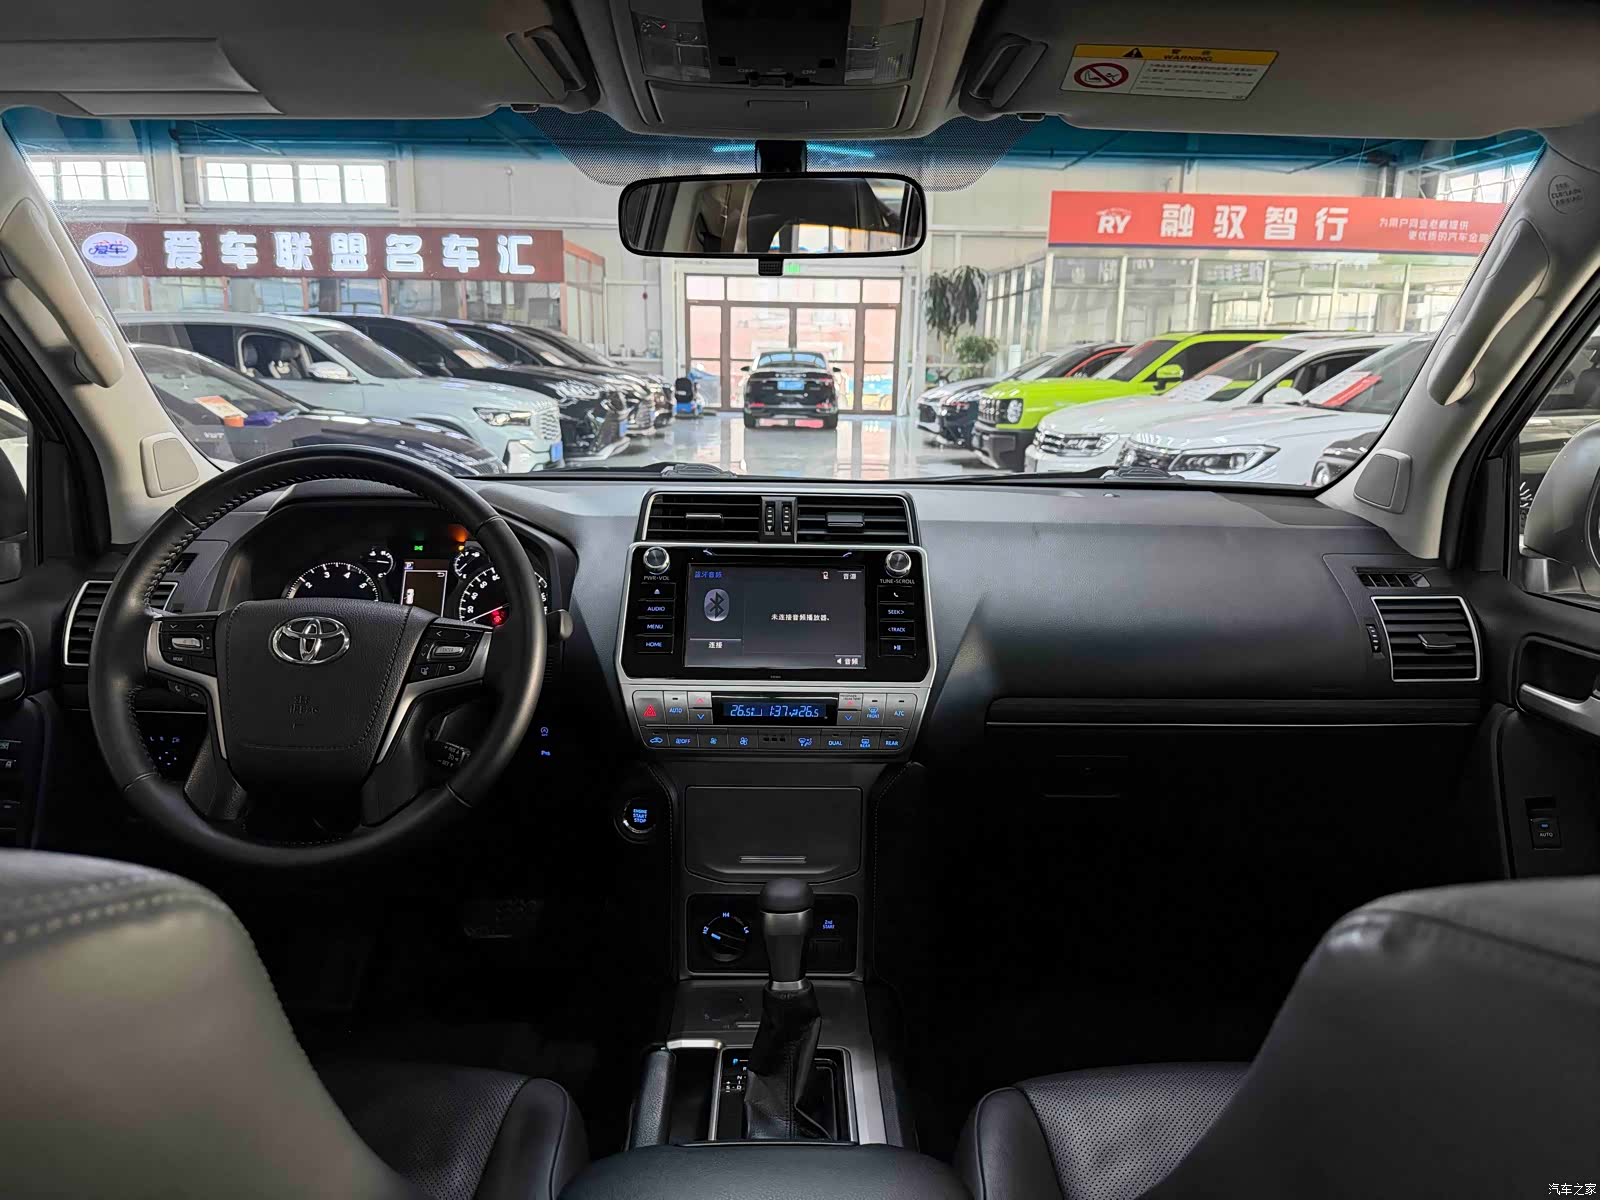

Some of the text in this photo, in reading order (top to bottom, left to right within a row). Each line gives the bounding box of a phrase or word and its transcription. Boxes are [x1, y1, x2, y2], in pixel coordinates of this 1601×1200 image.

[1097, 203, 1349, 241] RY 融驭智行
[163, 230, 536, 275] 爱车联盟名车汇
[479, 581, 488, 589] 60
[471, 592, 478, 600] 40
[467, 606, 474, 614] 20
[730, 704, 751, 717] 26.5
[798, 705, 819, 718] 26.5
